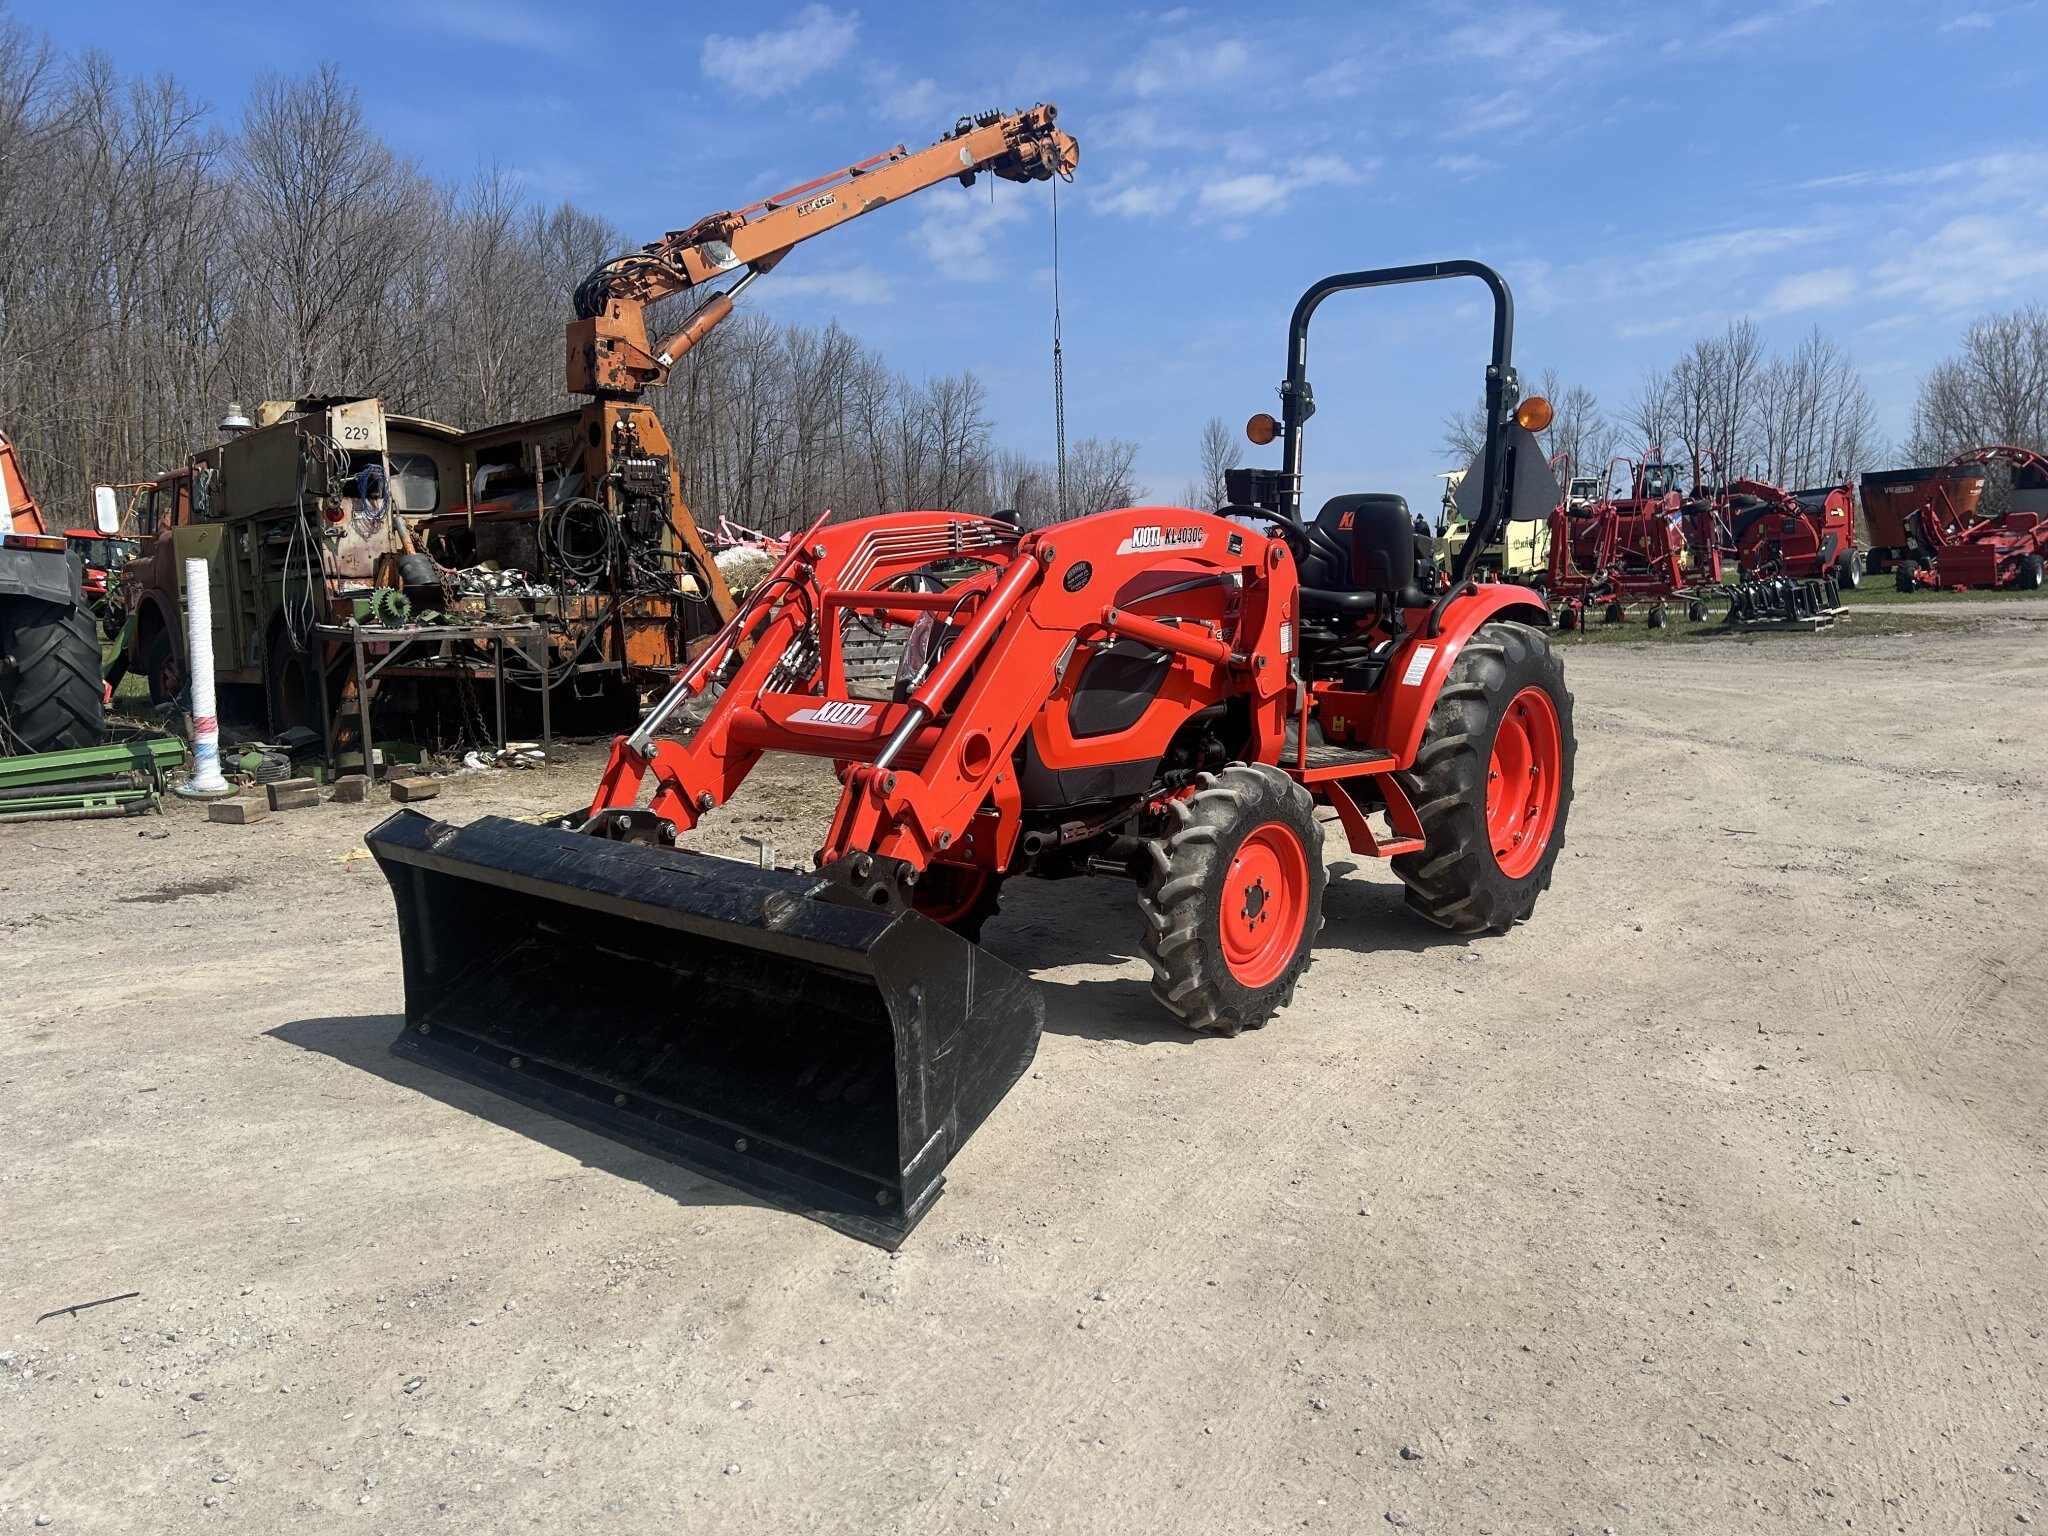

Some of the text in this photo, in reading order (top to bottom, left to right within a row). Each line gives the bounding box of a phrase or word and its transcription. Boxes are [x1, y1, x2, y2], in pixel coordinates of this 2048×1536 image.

[344, 427, 369, 440] 229
[1131, 526, 1204, 548] KIOTI KL4030C
[810, 701, 873, 725] KIOTI
